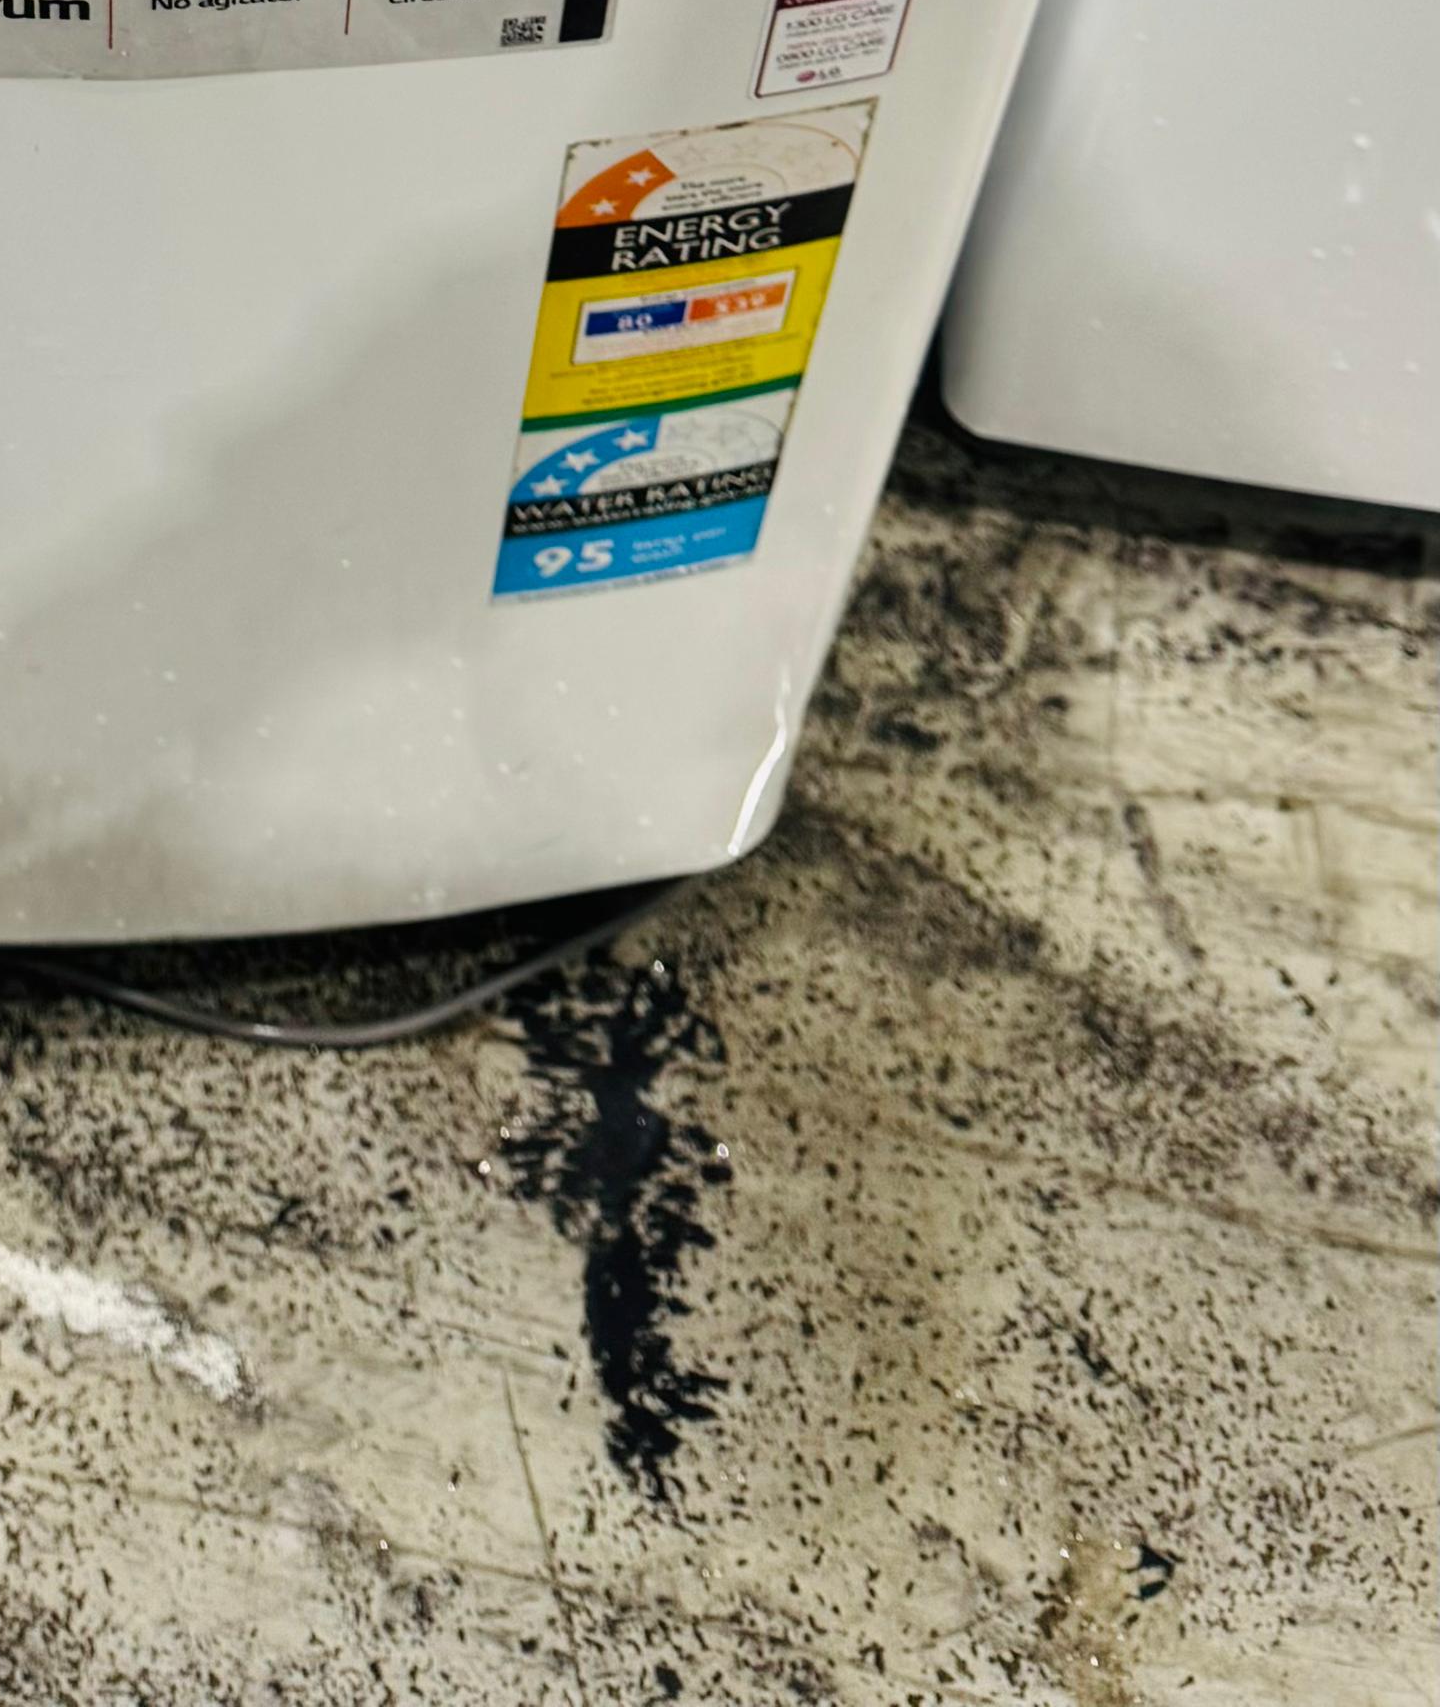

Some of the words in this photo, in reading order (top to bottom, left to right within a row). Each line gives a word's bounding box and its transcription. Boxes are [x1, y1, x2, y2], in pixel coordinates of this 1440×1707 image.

[613, 201, 793, 250] ENERGY
[611, 226, 784, 272] RATING
[532, 539, 616, 579] 95
